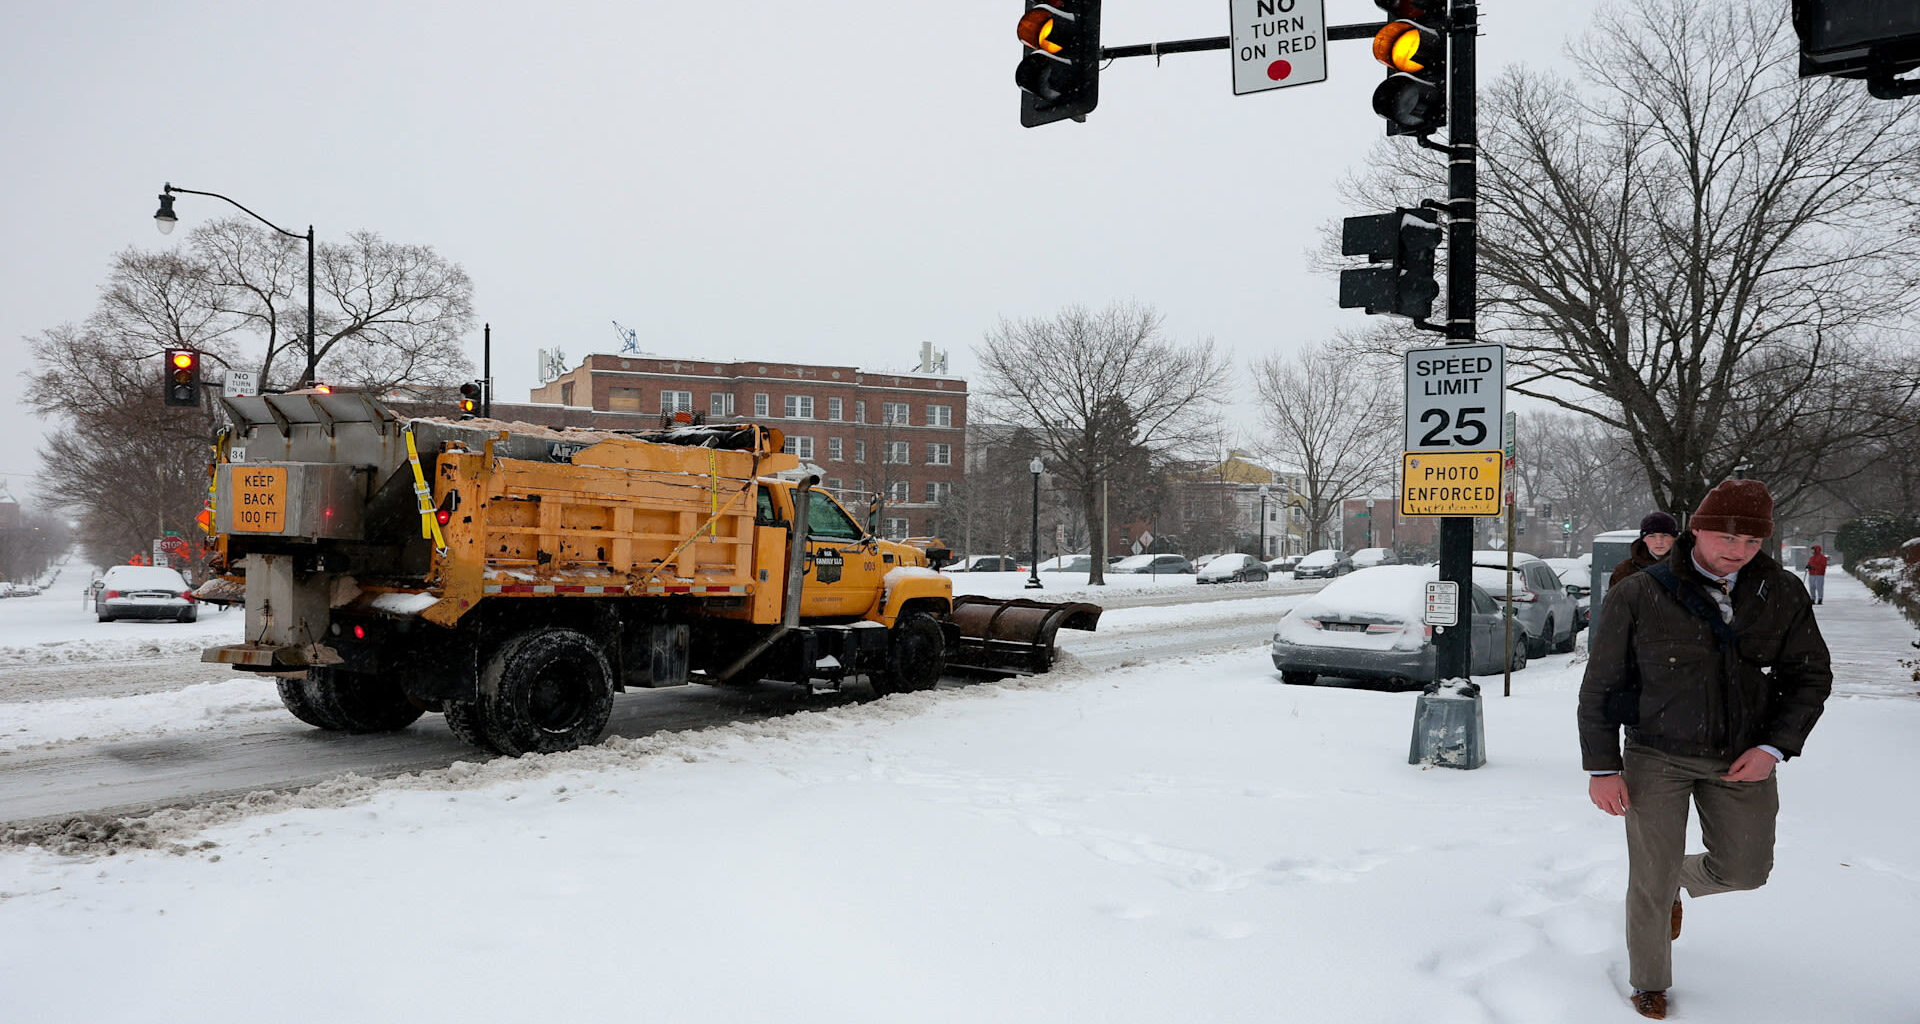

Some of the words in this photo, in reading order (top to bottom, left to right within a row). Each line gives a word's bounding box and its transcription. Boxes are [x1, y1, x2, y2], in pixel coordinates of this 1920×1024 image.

[1257, 0, 1295, 17] NO
[1251, 16, 1304, 39] TURN
[1241, 44, 1266, 61] ON
[1278, 35, 1316, 55] RED
[1416, 357, 1492, 376] SPEED
[1425, 378, 1483, 396] LIMIT
[1419, 407, 1487, 447] 25
[232, 451, 243, 459] 34
[1425, 466, 1479, 480] PHOTO
[244, 475, 275, 487] KEEP
[244, 493, 275, 505] BACK
[1408, 487, 1494, 501] ENFORCED
[241, 511, 260, 523] 100
[265, 511, 277, 523] FT
[161, 541, 182, 549] STOP
